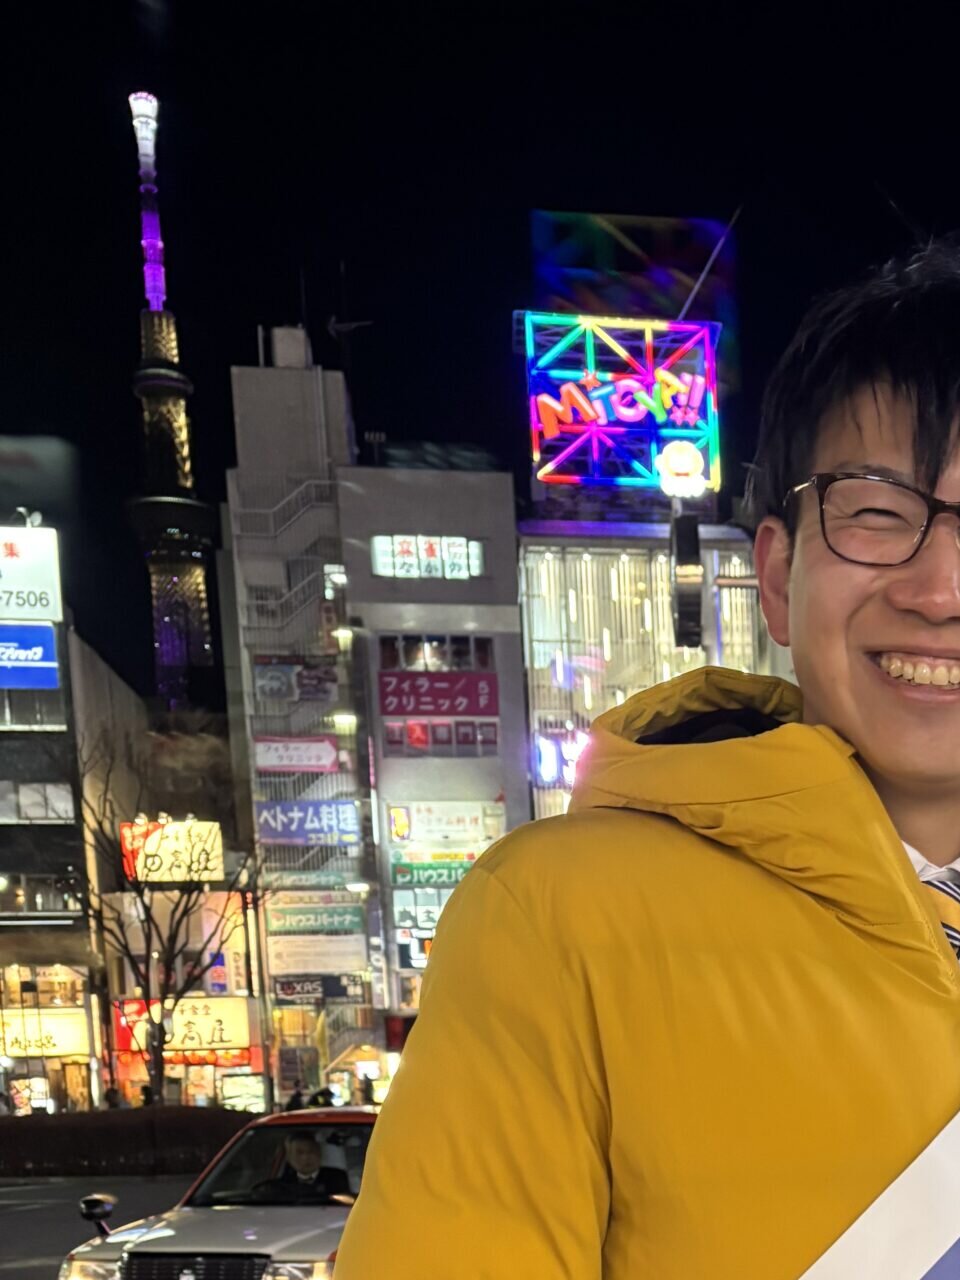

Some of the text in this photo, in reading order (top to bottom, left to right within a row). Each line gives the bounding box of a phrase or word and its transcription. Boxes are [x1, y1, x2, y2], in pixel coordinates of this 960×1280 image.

[384, 696, 468, 711] クリニック
[259, 804, 358, 832] ベトナム料理
[284, 913, 360, 927] ハウスパートナー
